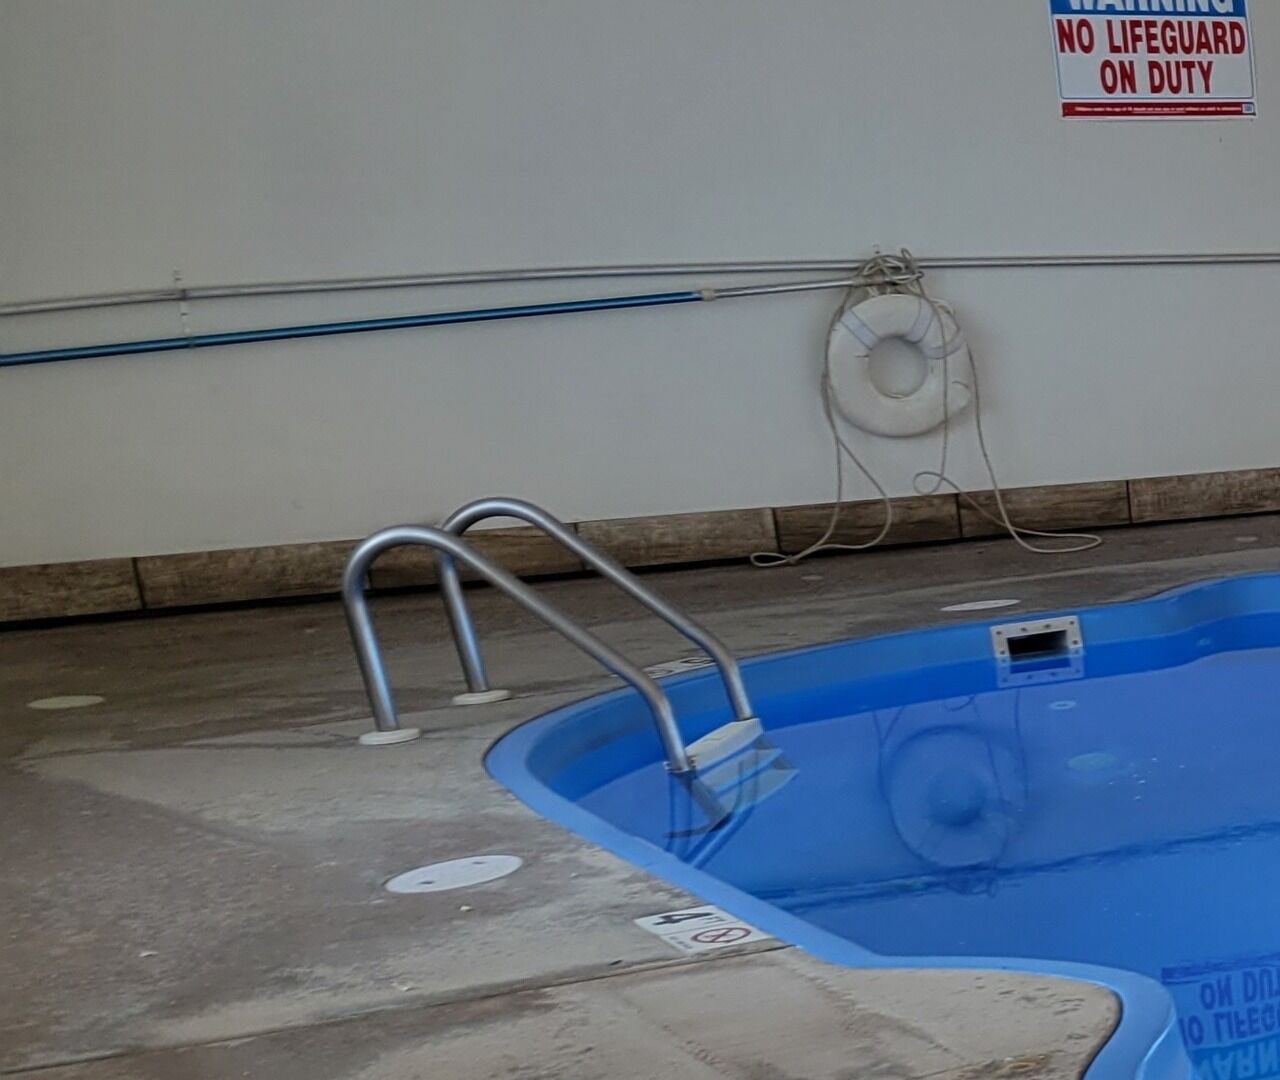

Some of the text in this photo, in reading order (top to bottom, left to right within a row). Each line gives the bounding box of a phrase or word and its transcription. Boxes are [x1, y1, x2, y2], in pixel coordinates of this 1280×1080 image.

[1055, 18, 1246, 55] NO LIFEGUARD
[1099, 59, 1214, 94] ON DUTY
